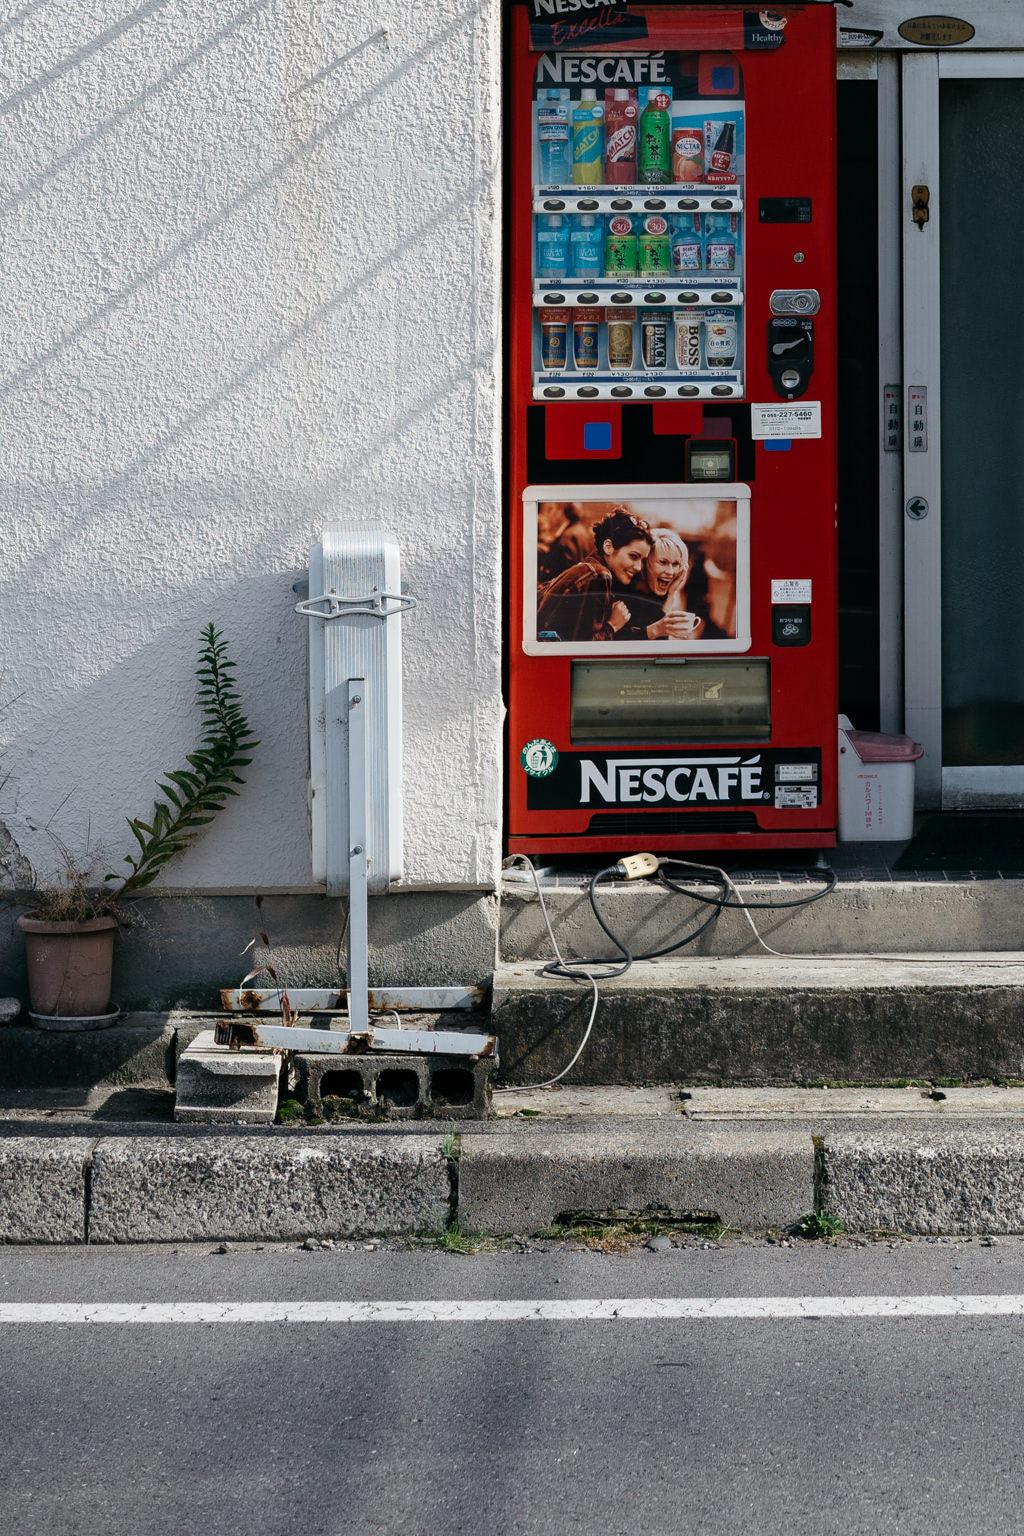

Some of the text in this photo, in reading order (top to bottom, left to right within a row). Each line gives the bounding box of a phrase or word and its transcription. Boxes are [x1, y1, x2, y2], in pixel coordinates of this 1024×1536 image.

[551, 7, 629, 46] Excella
[752, 33, 784, 44] Healthy
[536, 51, 666, 83] NESCAFÉ
[608, 127, 635, 158] MATCH
[654, 327, 665, 367] BLACK
[688, 325, 699, 366] BOSS
[888, 403, 899, 447] 自動扉
[913, 404, 924, 448] 自動扉
[524, 765, 554, 777] リサイクル
[579, 754, 764, 803] NESCAFÉ
